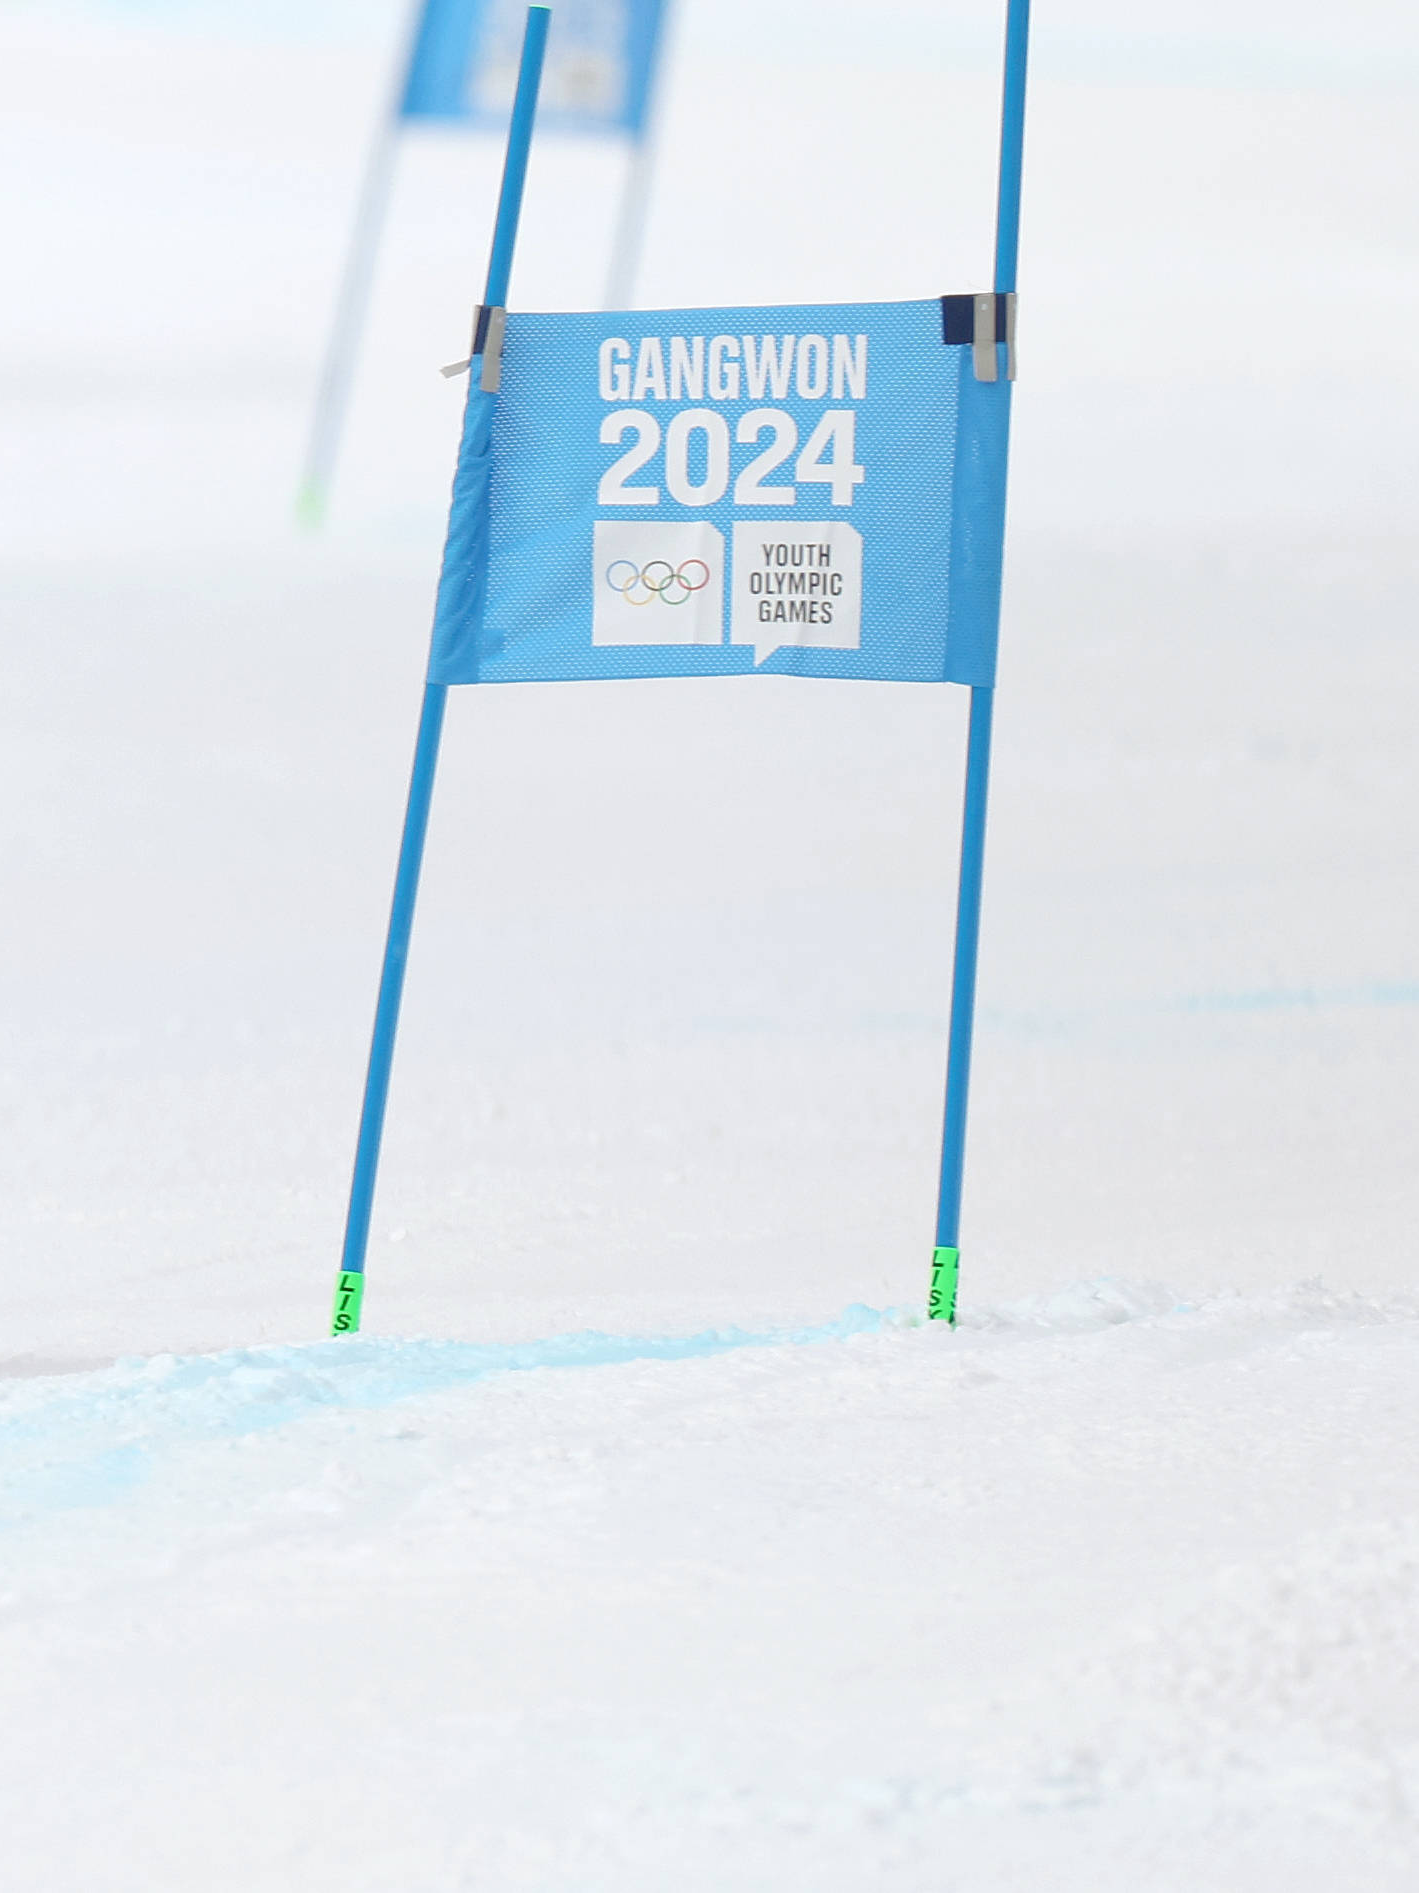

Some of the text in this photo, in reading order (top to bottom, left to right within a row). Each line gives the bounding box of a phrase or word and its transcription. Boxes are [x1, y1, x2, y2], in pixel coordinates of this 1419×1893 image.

[599, 334, 868, 401] GANGWON
[598, 408, 865, 506] 2024
[762, 543, 830, 567] YOUTH
[750, 572, 843, 596] OLYMPIC
[759, 600, 833, 624] GAMES
